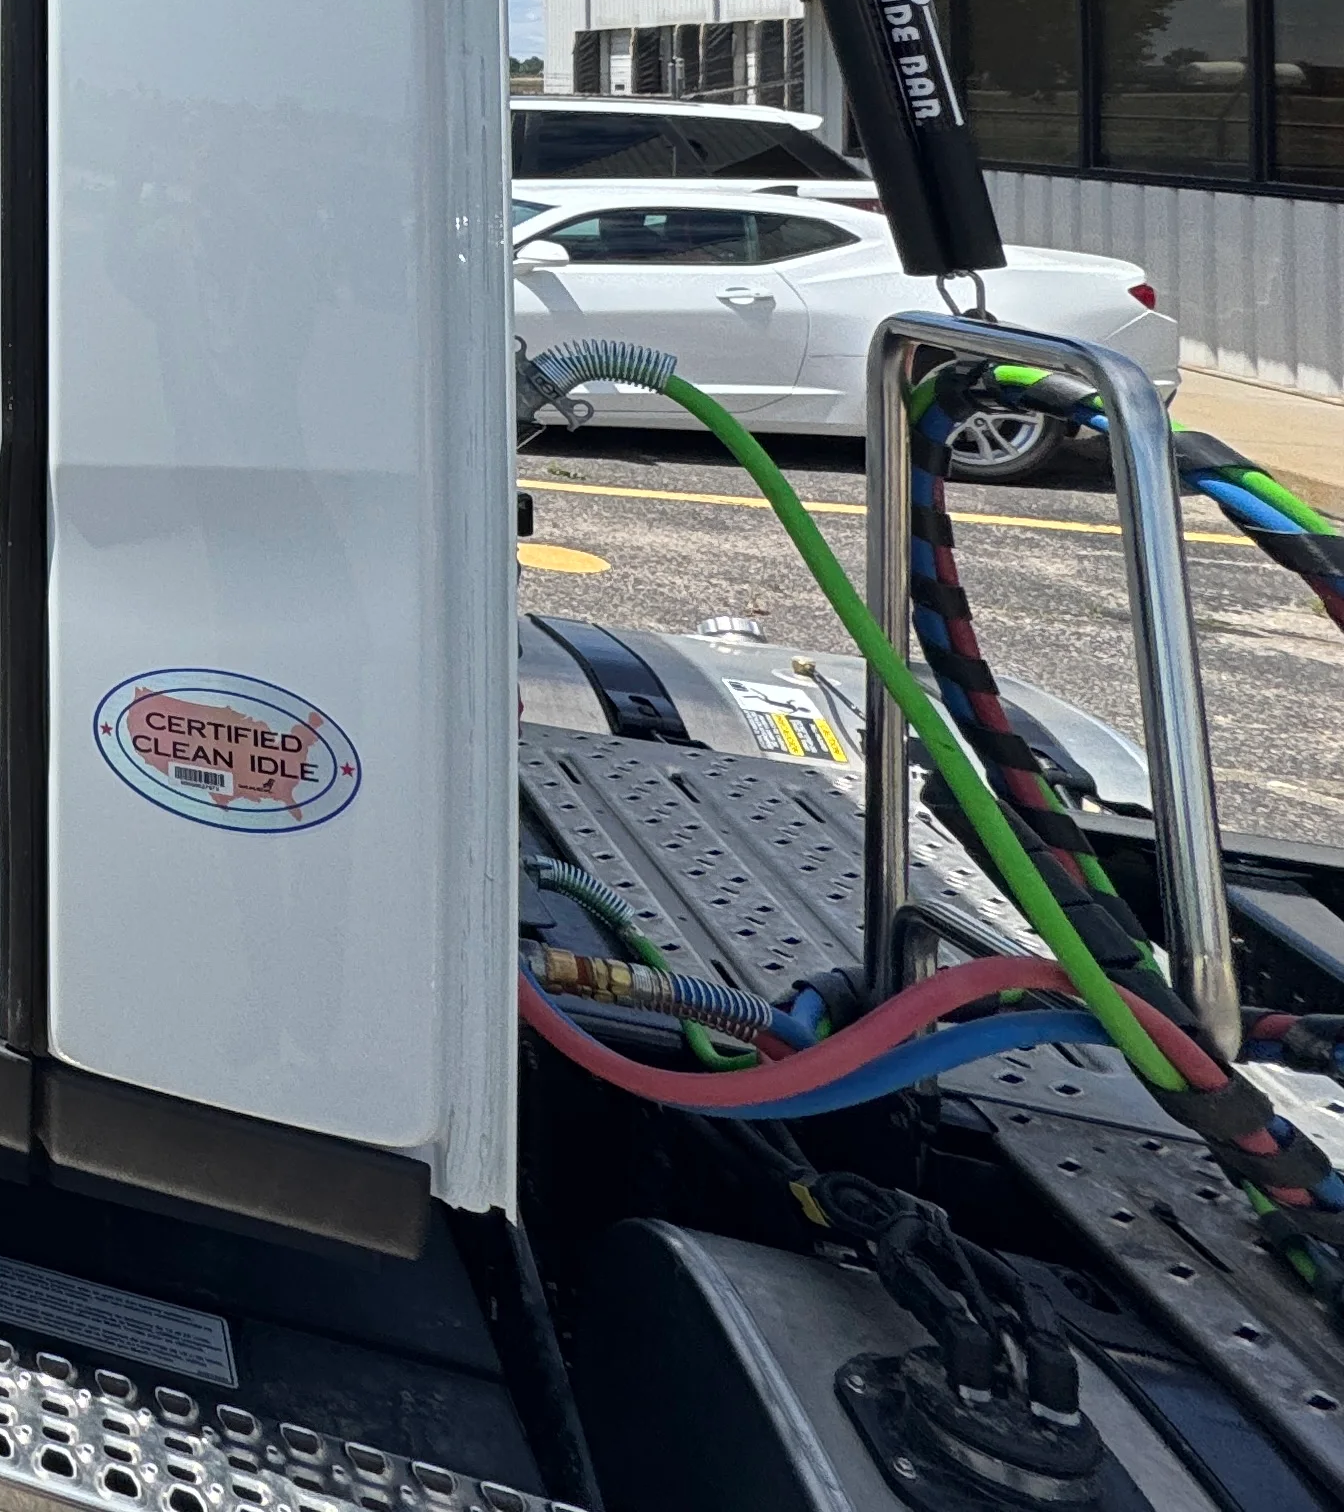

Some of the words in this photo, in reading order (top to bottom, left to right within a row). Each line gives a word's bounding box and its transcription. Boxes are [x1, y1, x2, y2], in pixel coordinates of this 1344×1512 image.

[899, 55, 942, 122] BAR
[144, 711, 303, 753] CERTIFIED
[131, 734, 234, 769] CLEAN
[249, 753, 320, 783] IDLE
